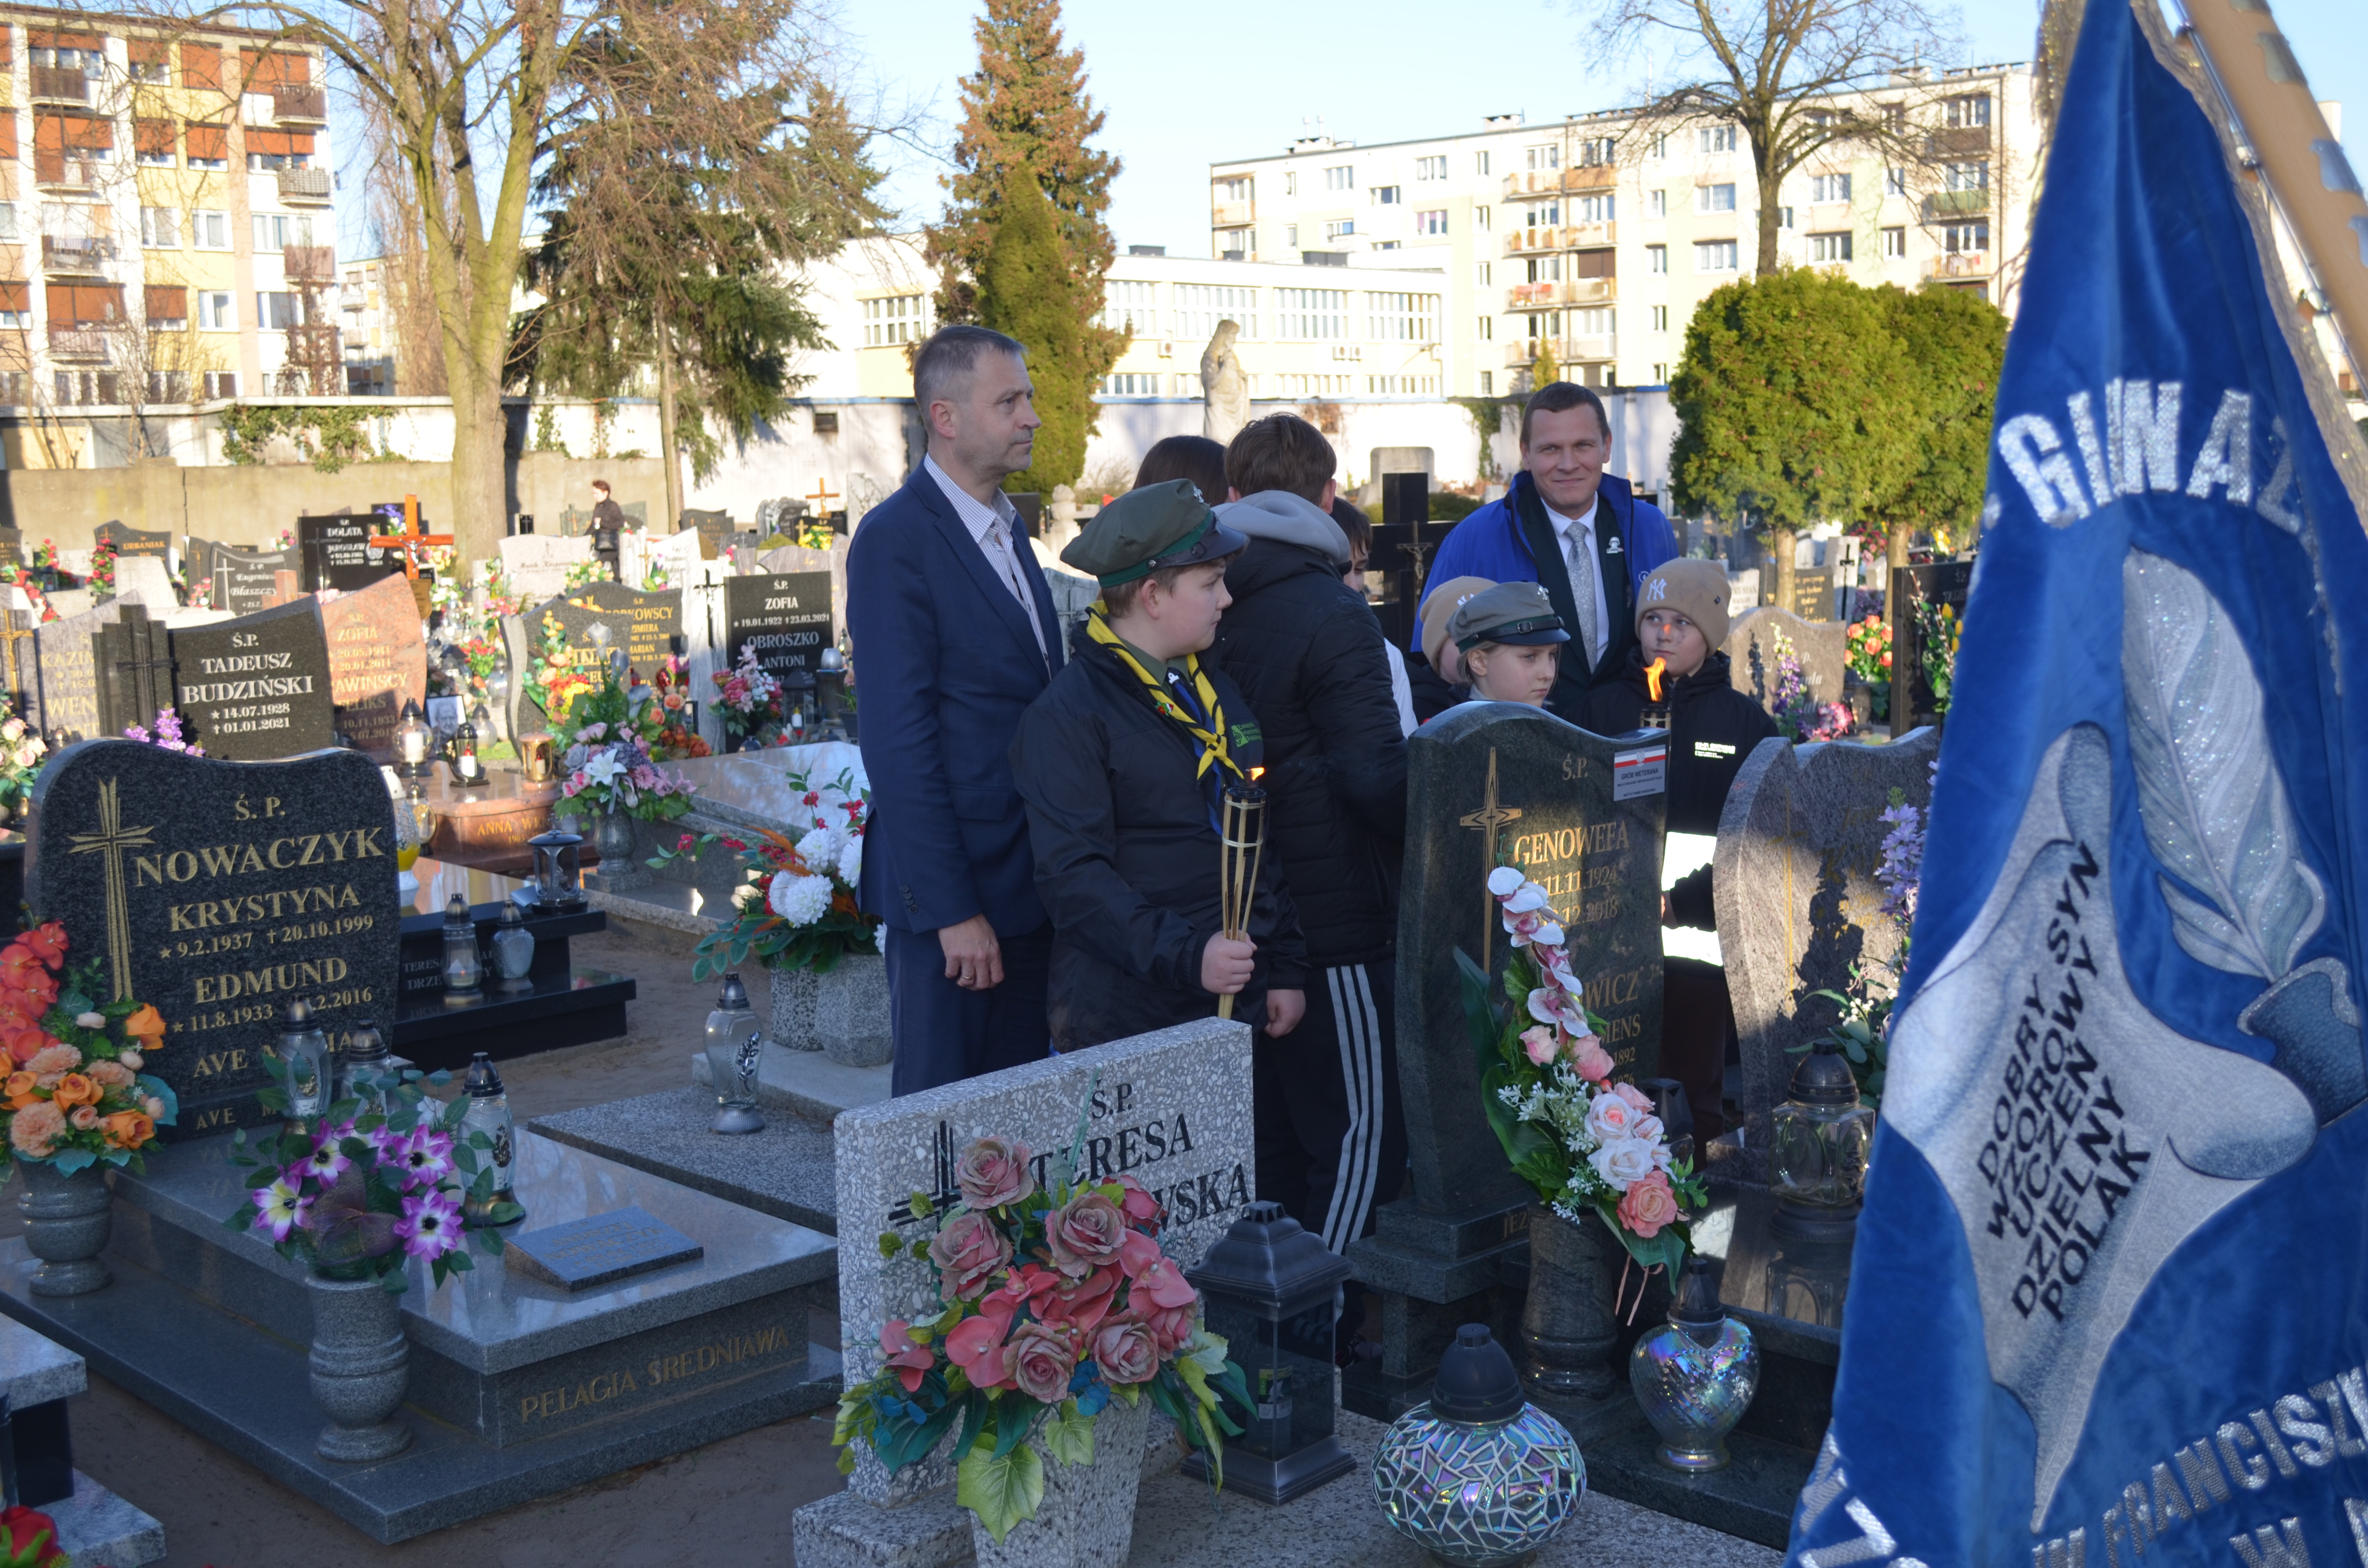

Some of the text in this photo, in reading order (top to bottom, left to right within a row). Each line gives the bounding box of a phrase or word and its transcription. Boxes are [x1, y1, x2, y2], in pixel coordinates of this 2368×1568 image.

[123, 541, 165, 550] URBANIAK
[328, 527, 363, 537] DOLATA
[774, 579, 789, 590] Ś.P.
[1646, 578, 1668, 602] NY
[765, 597, 799, 610] ZOFIA
[741, 613, 829, 627] 19.01.1922 23.03.2021
[233, 632, 259, 648] Ś.P.
[337, 627, 378, 641] ZOFIA
[747, 631, 820, 649] OBROSZKO
[202, 653, 292, 674] TADEUSZ
[764, 655, 805, 668] ANTONI
[182, 675, 314, 704] BUDZIŃSKI
[223, 703, 290, 719] 14.07.1928
[223, 717, 290, 734] 01.01.2021
[1563, 754, 1588, 781] Ś.P.
[1621, 768, 1659, 780] GRÓB WETERANA
[235, 794, 285, 821] Ś. P.
[478, 821, 513, 836] ANNA
[1515, 821, 1629, 865] GENOWEFA
[133, 827, 384, 887] NOWACZYK
[1543, 866, 1617, 896] 11.11.1924
[169, 883, 361, 932] KRYSTYNA
[1543, 896, 1618, 928] .12.2018
[177, 915, 374, 958] 9.2.1937 20.10.1999
[195, 957, 347, 1004] EDMUND
[1580, 970, 1639, 1010] WICZ
[191, 987, 372, 1031] 11.8.1933 .2.2016
[1977, 840, 2099, 1188] DOBRY SYN
[194, 1049, 247, 1078] AVE
[1614, 1046, 1636, 1066] 1892
[1091, 1079, 1133, 1120] Ś.P.
[1986, 935, 2098, 1239] WZOROWY
[197, 1108, 235, 1130] AVE
[2011, 1075, 2124, 1319] DZIELNY
[552, 1221, 635, 1247] ANDRZEJ
[2039, 1127, 2151, 1323] POLAK
[542, 1226, 667, 1262] NOWACZYK
[520, 1369, 638, 1423] PELAGIA
